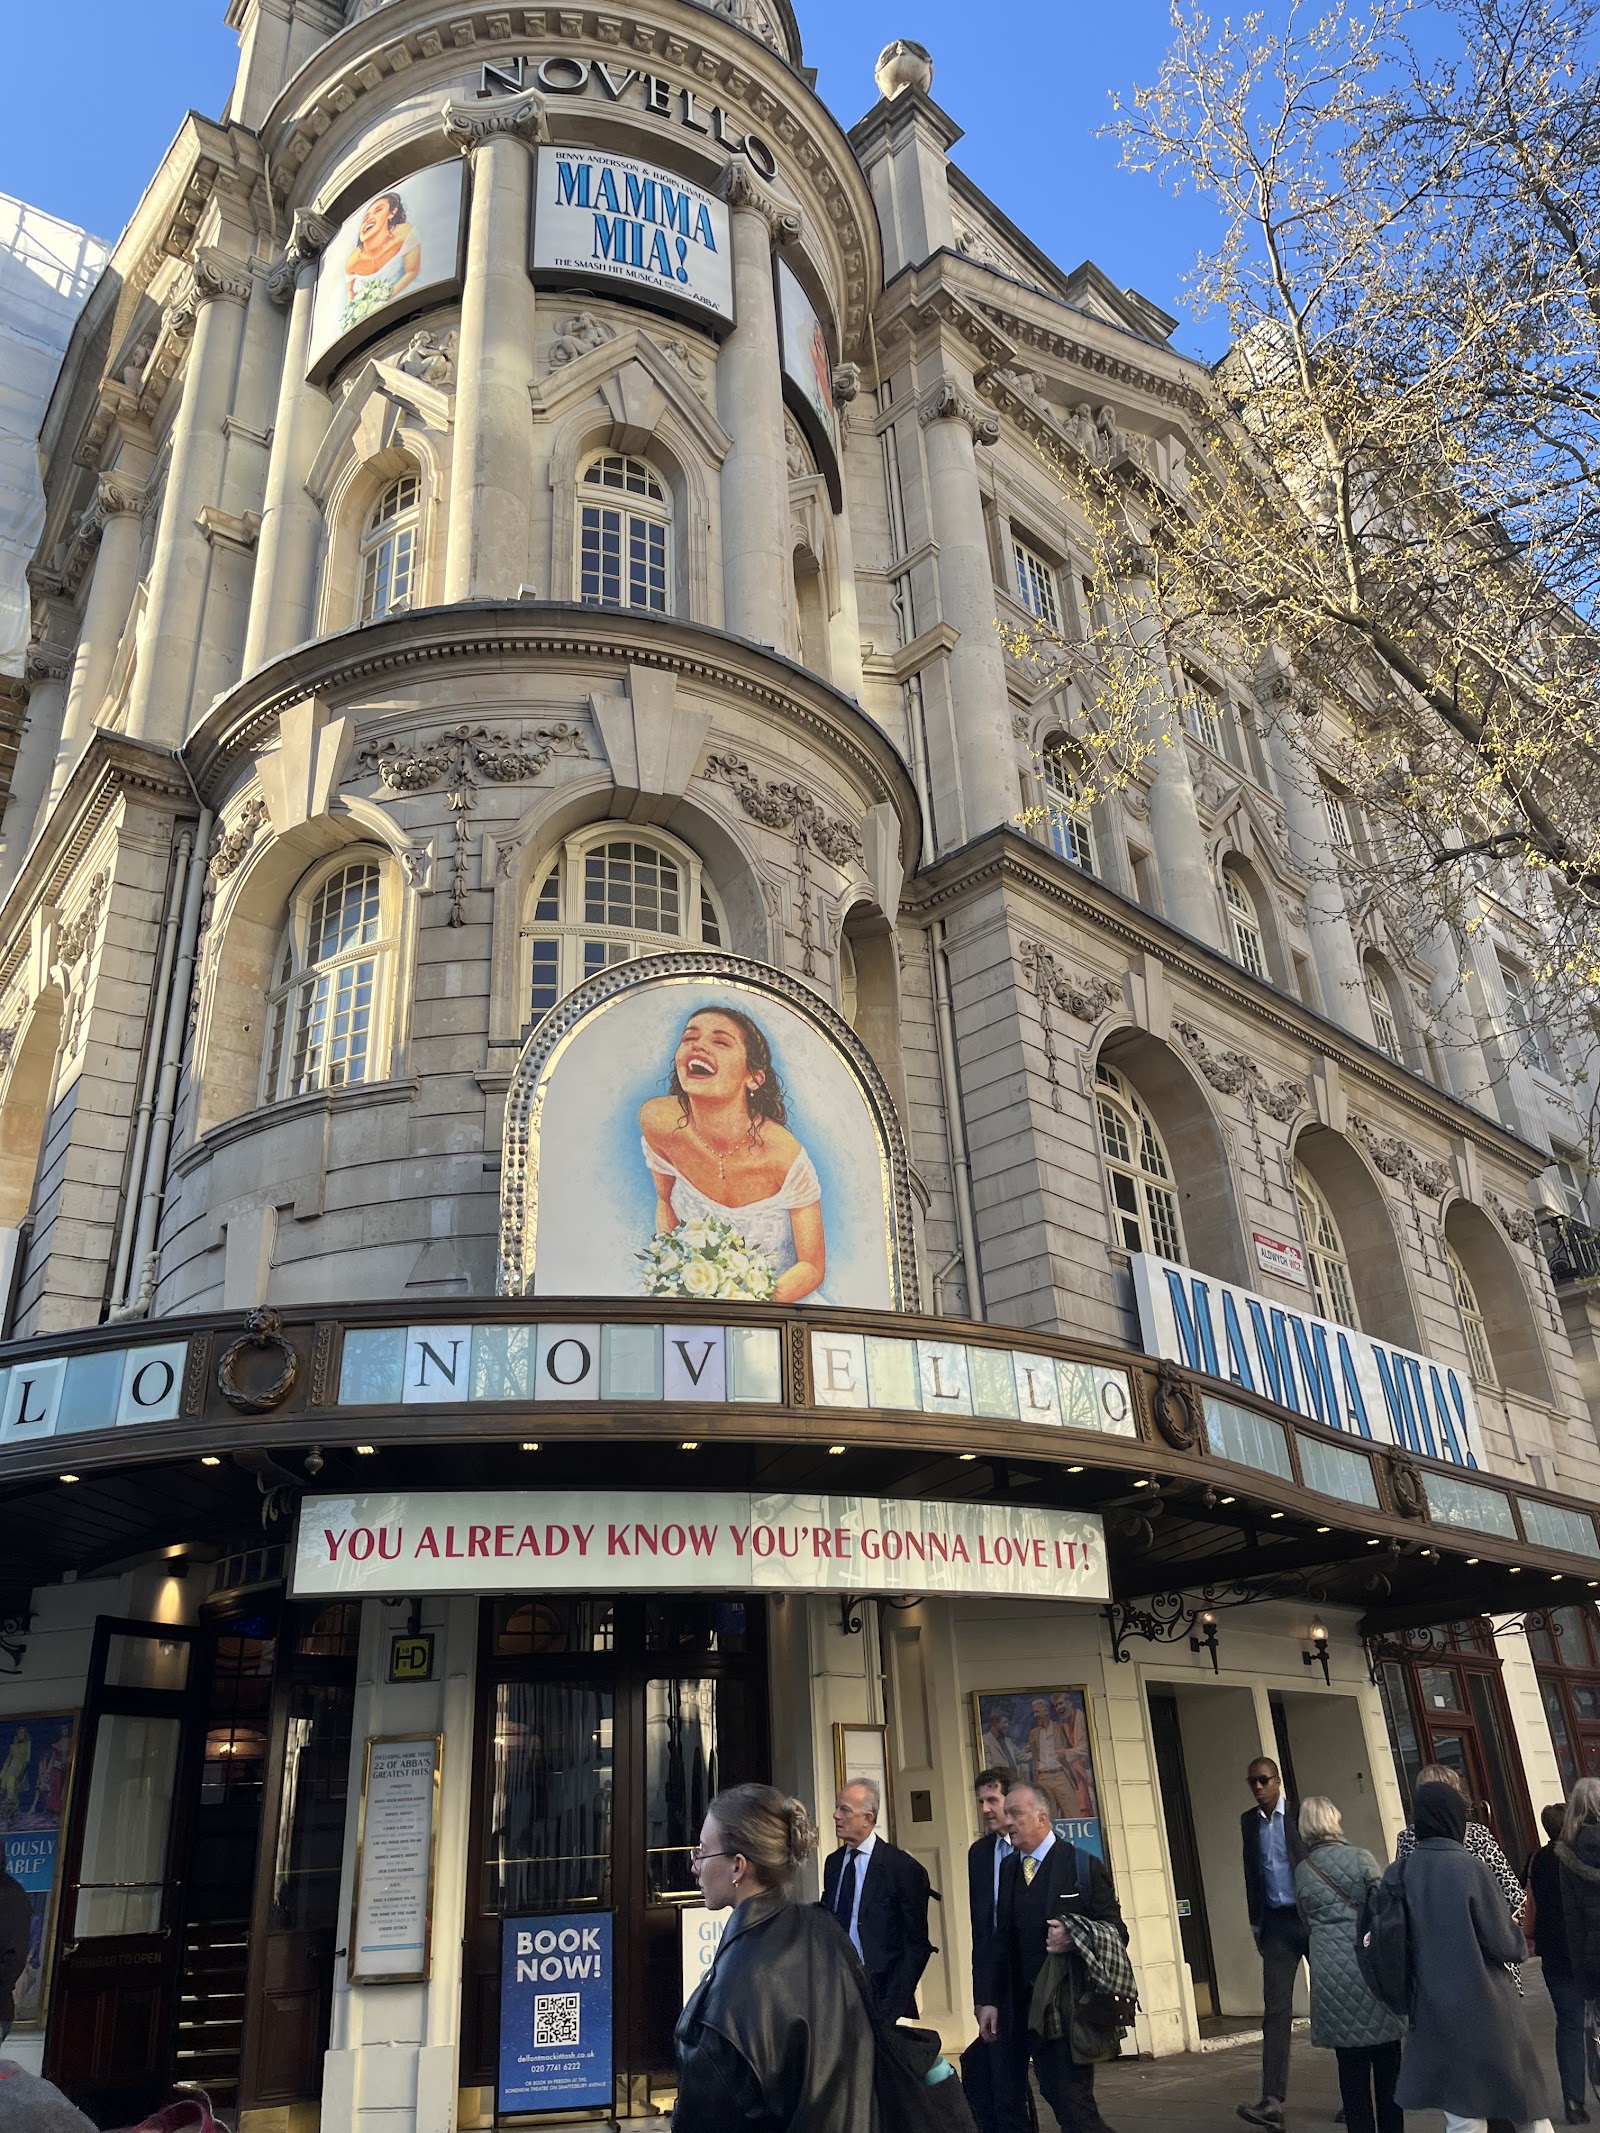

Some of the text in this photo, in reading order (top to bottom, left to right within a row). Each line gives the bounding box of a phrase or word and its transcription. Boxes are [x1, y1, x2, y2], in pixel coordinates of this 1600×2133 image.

[476, 56, 779, 182] NOVELLO
[555, 152, 585, 161] BENNY
[587, 155, 639, 172] ANDERSSON
[642, 168, 650, 176] &
[554, 161, 719, 254] MAMMA
[591, 212, 690, 285] MIA!
[554, 258, 664, 287] THE SMASH HIT MUSICAL
[1163, 1267, 1479, 1470] MAMMA MIA!
[324, 1523, 1091, 1572] YOU ALREADY KNOW YOU'RE GONNA LOVE IT!
[372, 1767, 432, 1779] GREATEST HITS:
[374, 1758, 432, 1770] 22 OF ABBA'S
[1055, 1821, 1095, 1840] STIC
[5, 1840, 56, 1857] LOUSLY
[5, 1858, 46, 1874] ABLE'
[517, 1927, 601, 1956] BOOK
[516, 1954, 601, 1983] NOW!
[517, 2050, 595, 2063] delfontmackintosh.co.uk
[530, 2061, 581, 2073] 020 7741 6222
